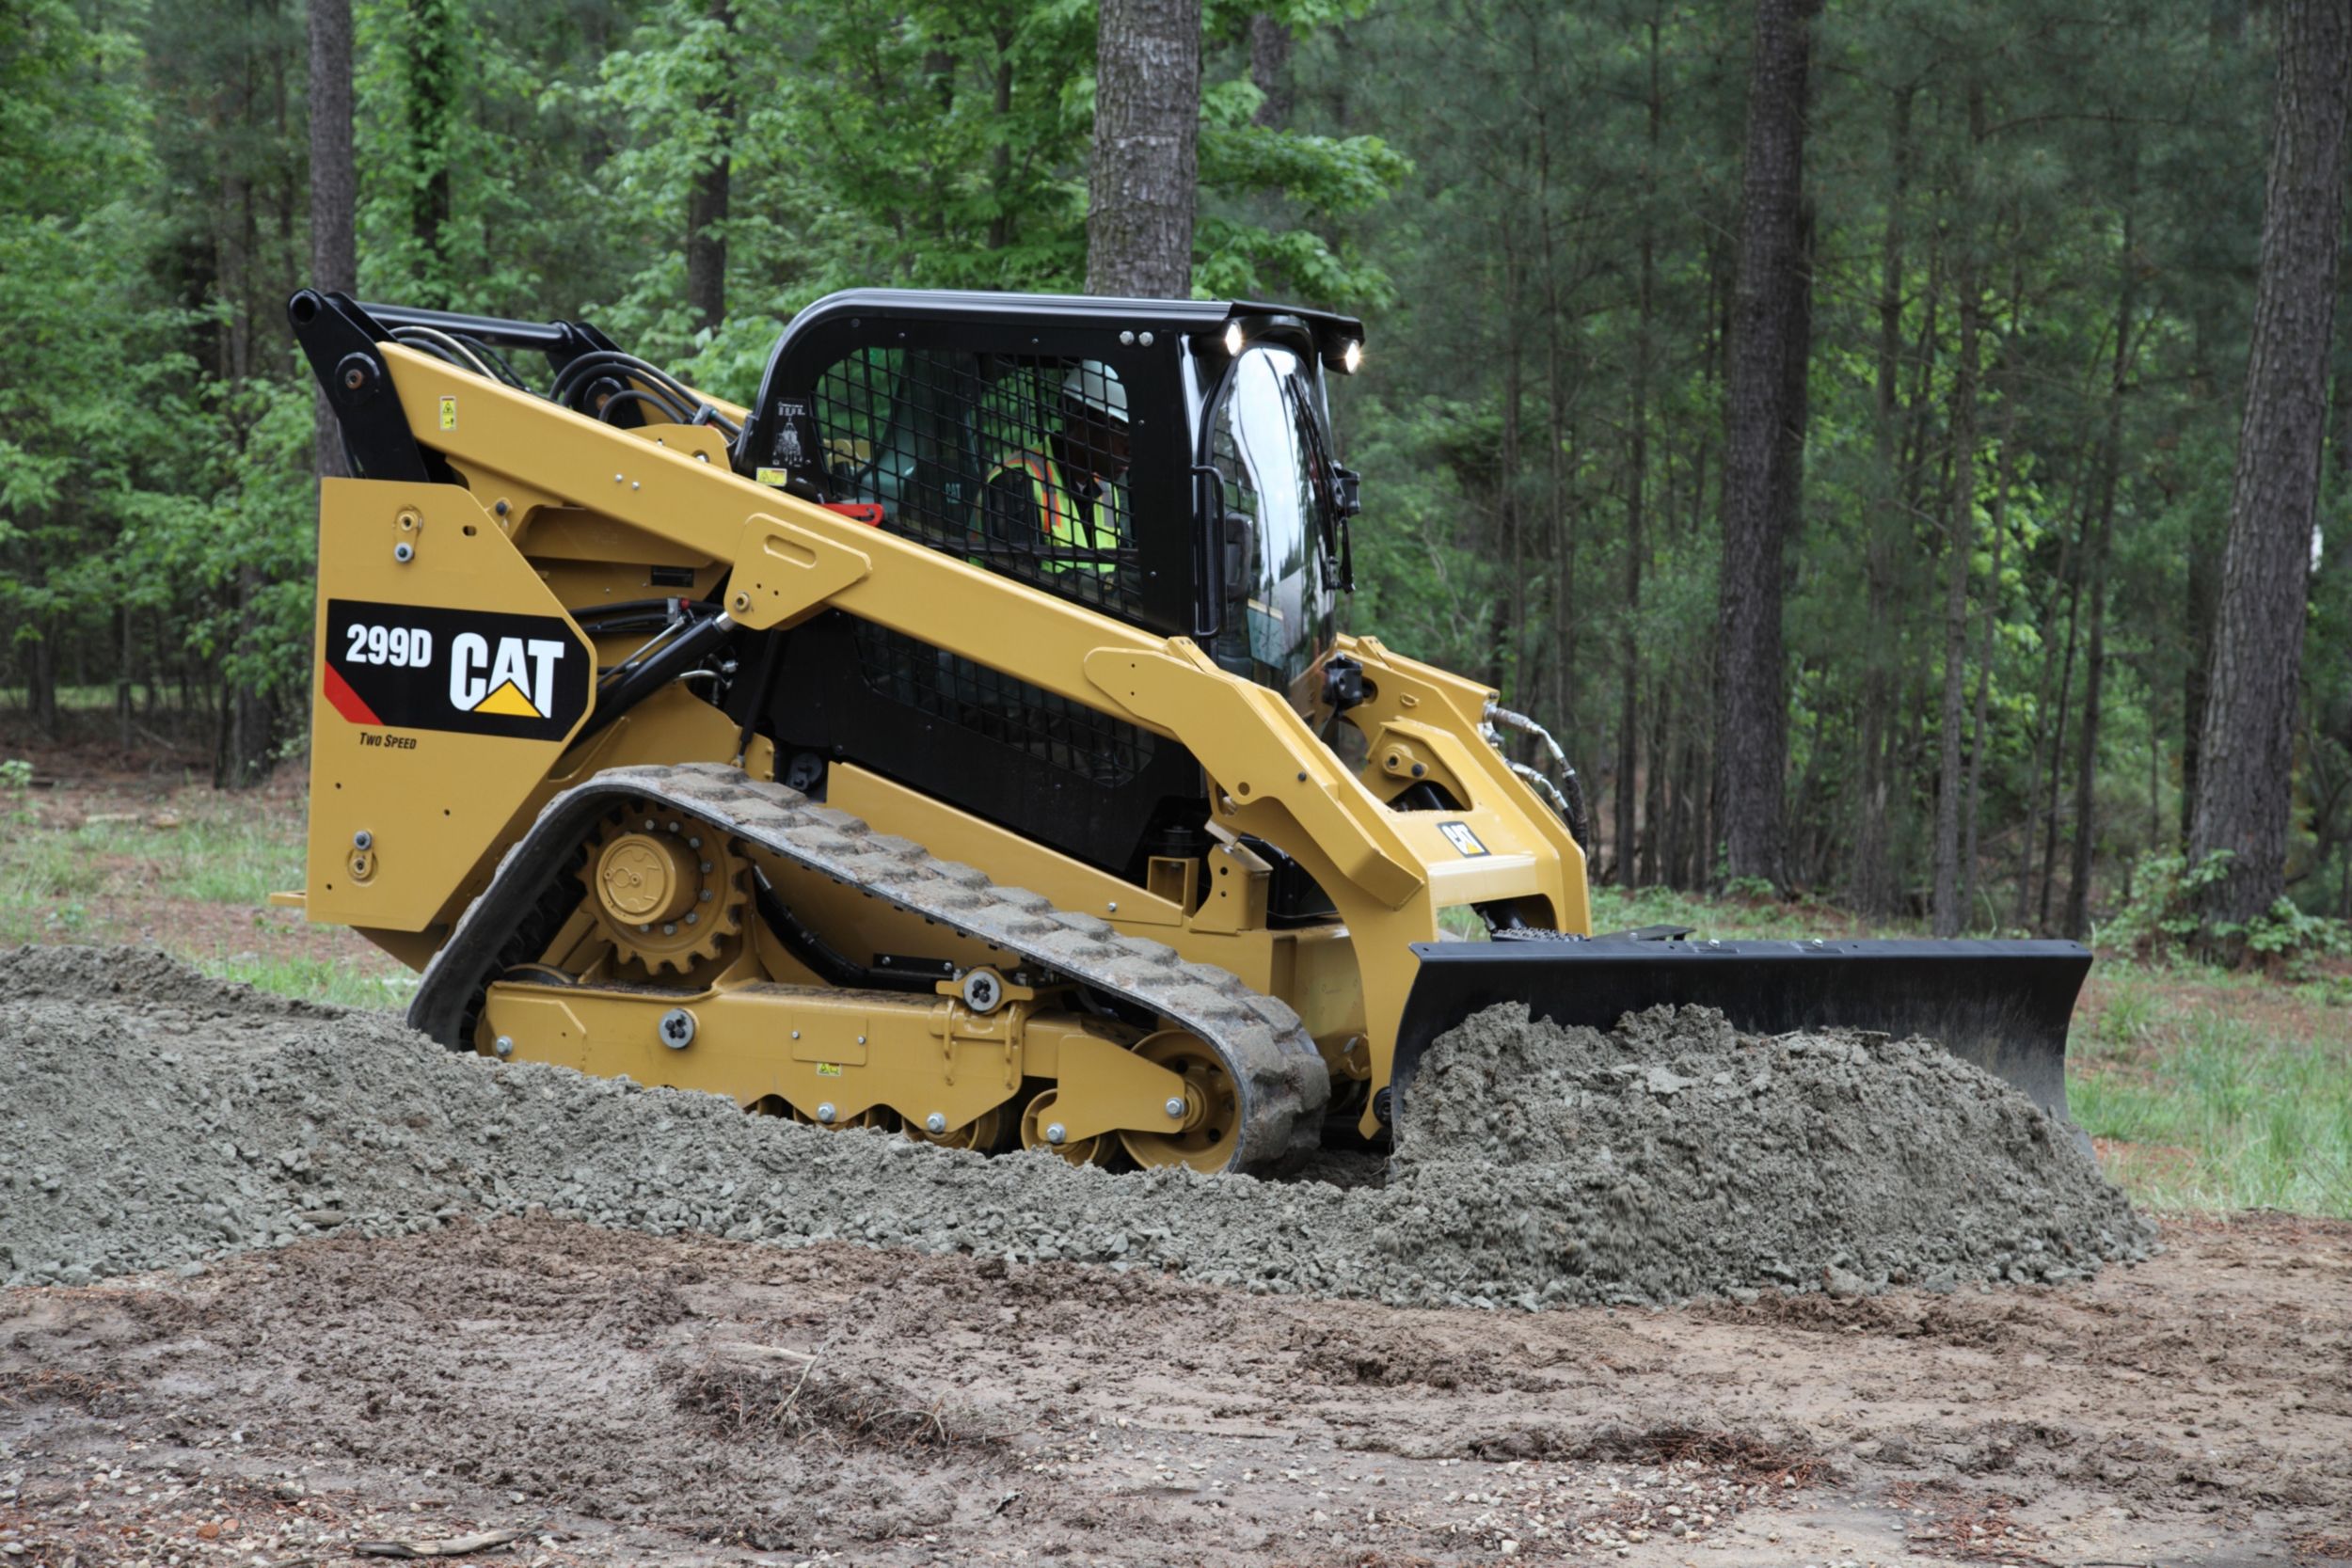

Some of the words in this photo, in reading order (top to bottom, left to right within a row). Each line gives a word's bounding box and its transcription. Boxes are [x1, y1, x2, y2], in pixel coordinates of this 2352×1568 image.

[345, 623, 433, 668] 299D
[449, 632, 564, 720] CAT
[359, 732, 382, 747] TWO
[384, 734, 418, 750] SPEED
[1440, 824, 1486, 854] CAT
